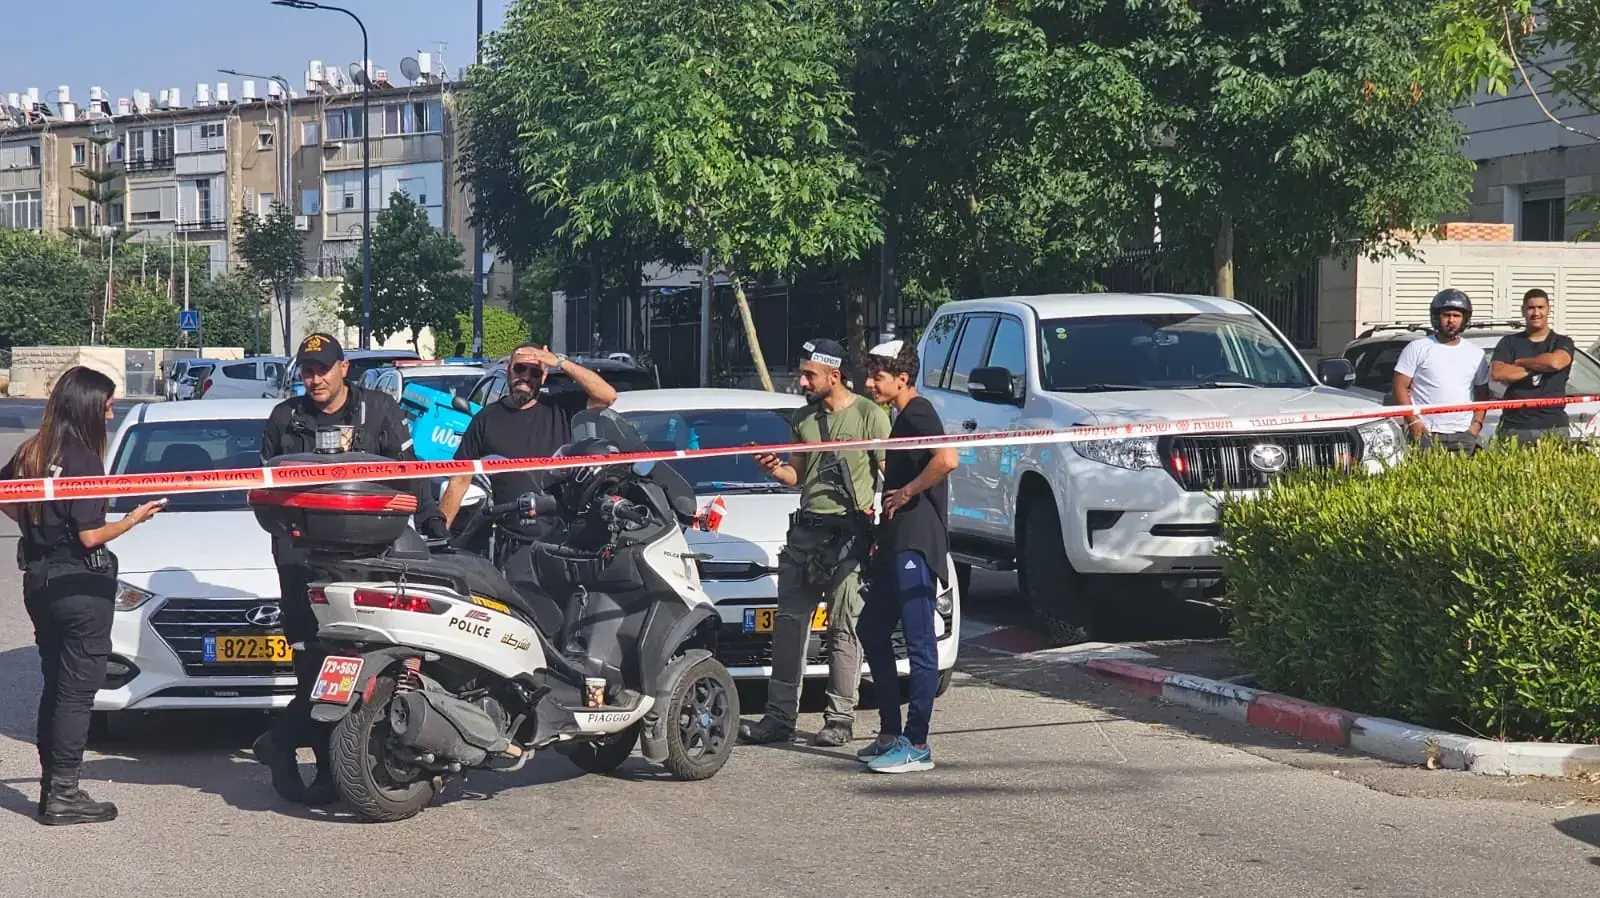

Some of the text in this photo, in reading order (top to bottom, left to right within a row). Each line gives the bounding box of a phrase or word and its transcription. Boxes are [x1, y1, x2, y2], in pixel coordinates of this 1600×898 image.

[812, 353, 840, 366] משטרה
[1103, 425, 1118, 436] אין
[1138, 422, 1172, 433] ישראל
[1193, 419, 1233, 431] משטרת
[431, 425, 463, 448] Wo
[278, 461, 469, 479] משטרת ישראל אין מעבר
[203, 471, 219, 482] אין
[224, 471, 260, 482] מעבר
[449, 617, 491, 638] POLICE
[587, 713, 631, 722] PIAGGIO
